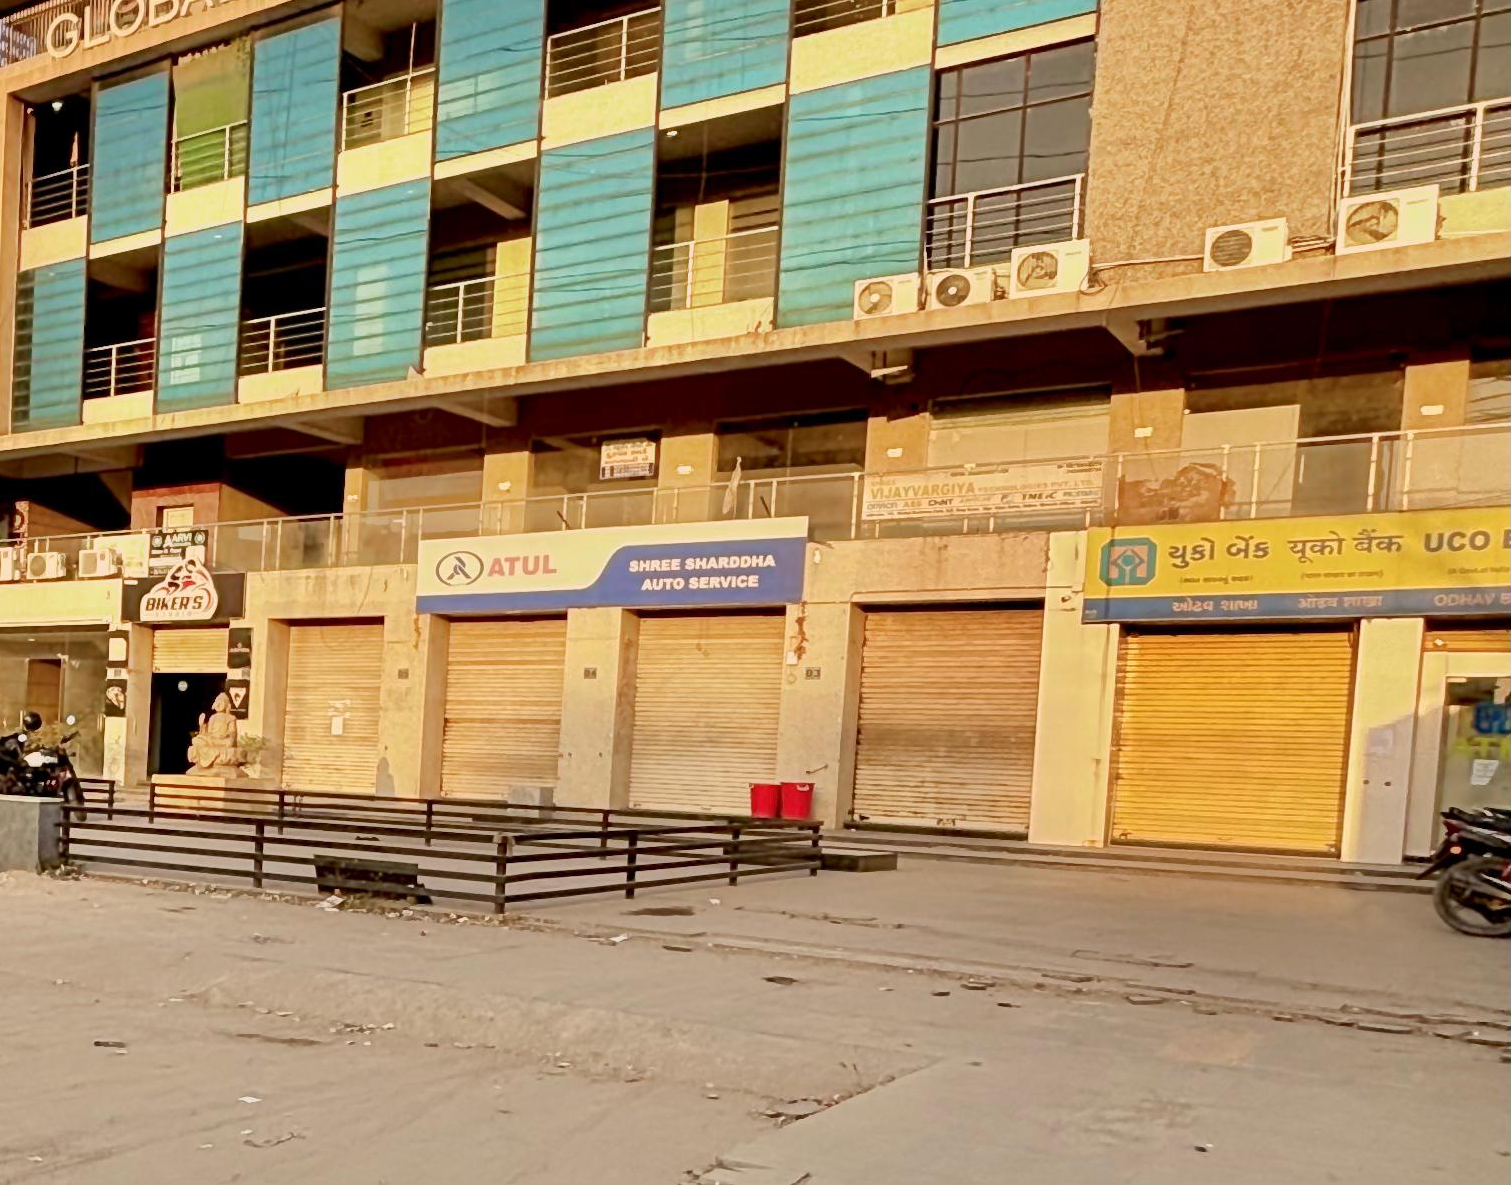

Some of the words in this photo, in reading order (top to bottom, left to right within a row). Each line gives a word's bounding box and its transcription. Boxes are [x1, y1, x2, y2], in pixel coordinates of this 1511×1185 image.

[870, 482, 976, 500] VIJAYVARGIYA
[1287, 530, 1346, 564] यूको
[1352, 528, 1404, 554] बैंक
[1423, 529, 1491, 553] UCO
[1168, 536, 1216, 569] યુકો
[488, 554, 557, 576] ATUL
[628, 558, 682, 572] SHREE
[685, 554, 776, 570] SHARDDHA
[641, 577, 685, 591] AUTO
[688, 574, 759, 590] SERVICE
[1433, 593, 1496, 608] ODHAV
